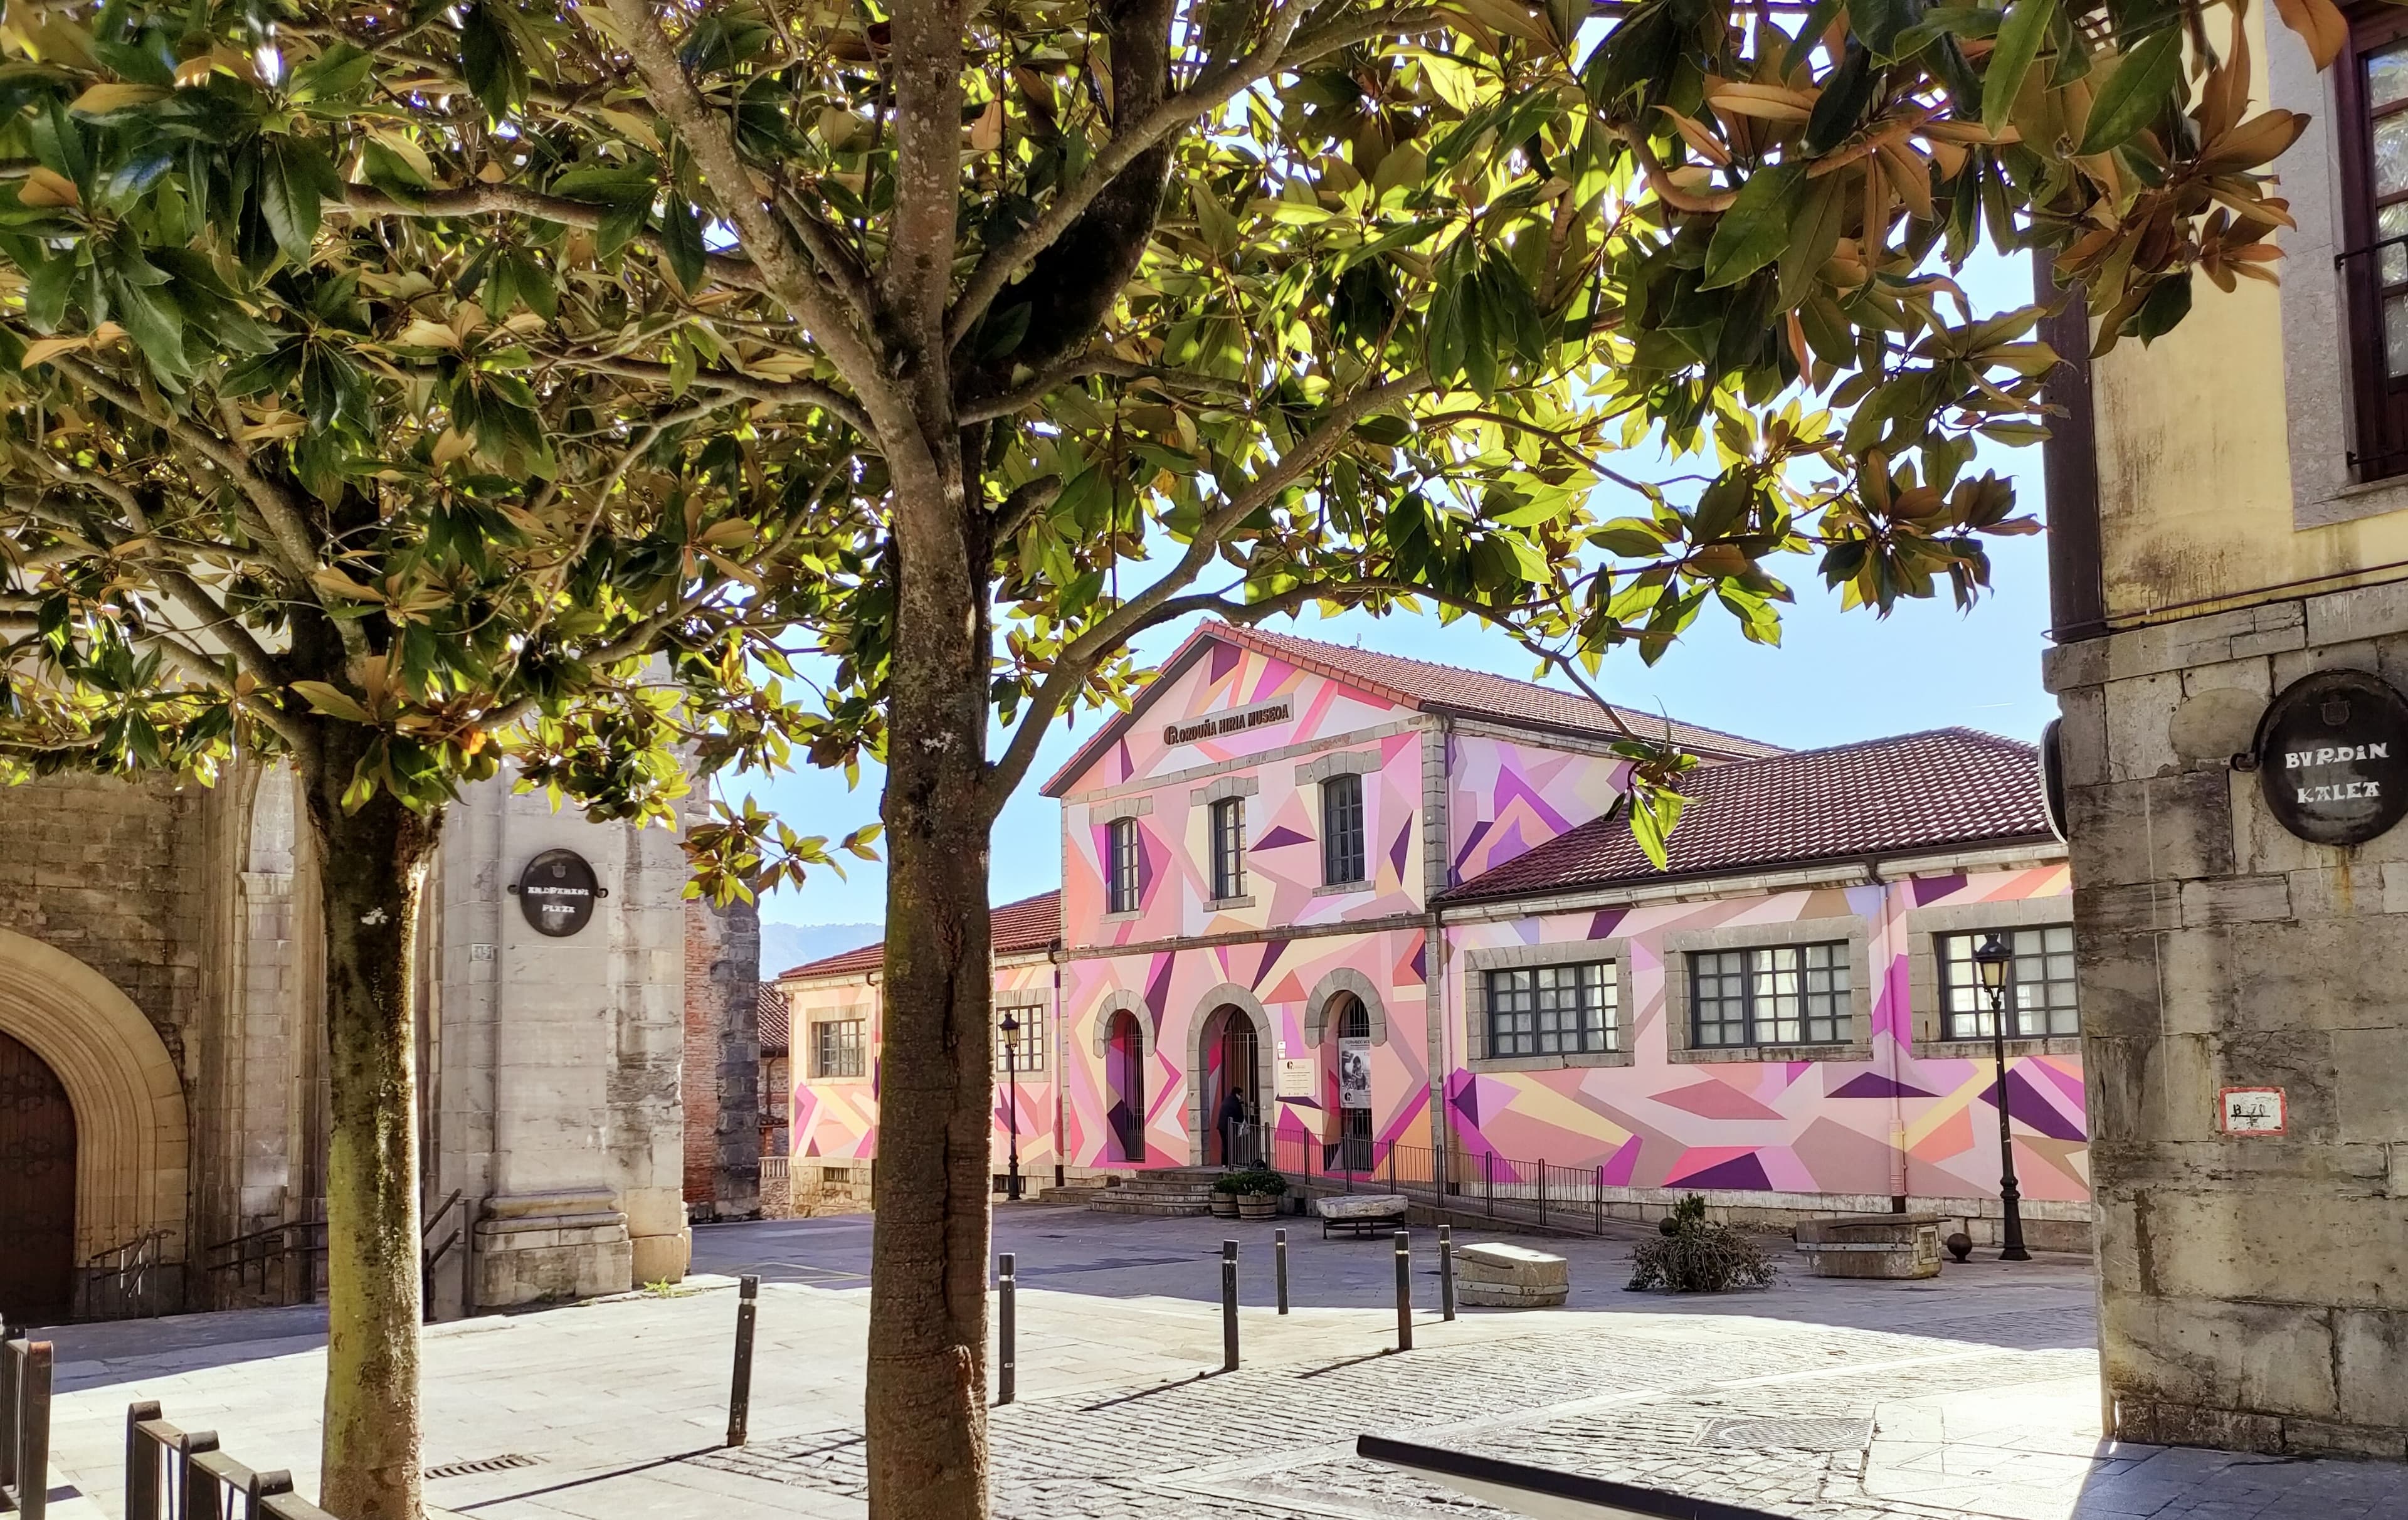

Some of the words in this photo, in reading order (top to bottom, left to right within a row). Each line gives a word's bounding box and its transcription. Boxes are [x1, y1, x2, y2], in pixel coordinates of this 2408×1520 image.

[1179, 719, 1217, 743] ORDUÑA
[1218, 714, 1245, 734] HIRIA
[1248, 704, 1289, 727] MUSEOA
[2297, 781, 2381, 803] KALEA
[542, 904, 576, 913] PLAZA
